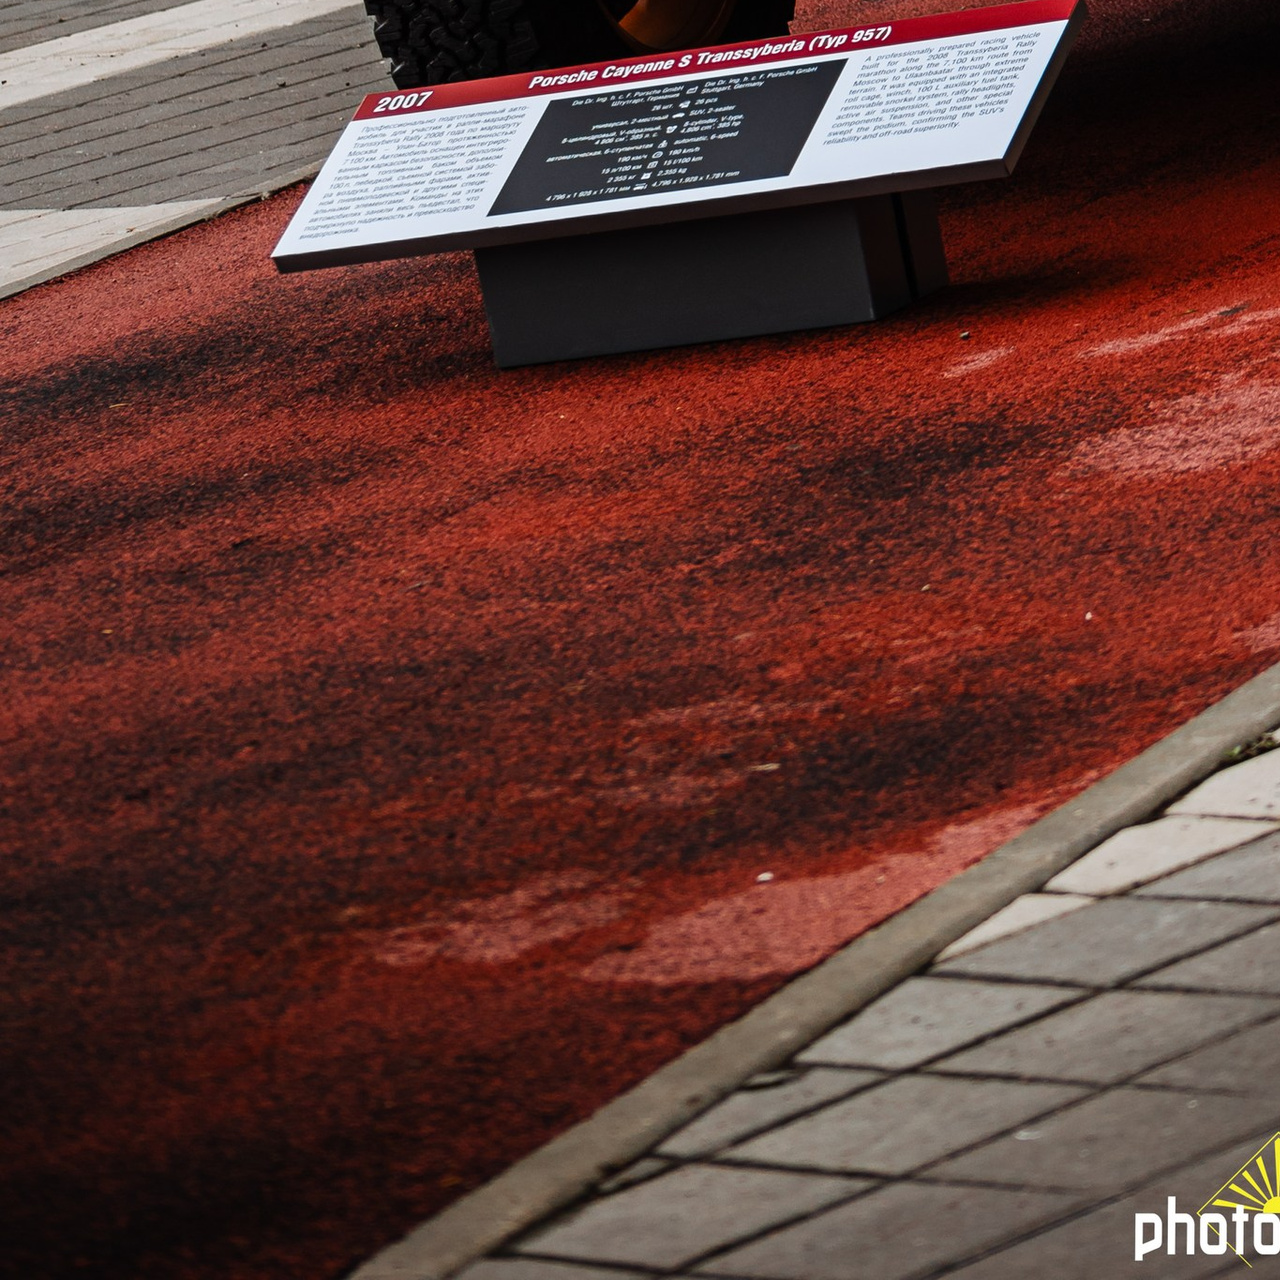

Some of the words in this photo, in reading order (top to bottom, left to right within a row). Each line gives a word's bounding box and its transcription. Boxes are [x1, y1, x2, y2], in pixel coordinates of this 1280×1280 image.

[528, 69, 598, 89] Porsche
[601, 59, 675, 78] Cayenne
[677, 54, 693, 68] S
[696, 41, 807, 67] Transsyberia
[808, 34, 848, 51] (Typ
[851, 25, 892, 43] 957)
[860, 62, 880, 71] built
[926, 51, 949, 61] 2008
[956, 44, 1009, 56] Transsyberia
[1015, 39, 1037, 48] Rally
[864, 55, 872, 63] A
[875, 47, 935, 62] professionally
[937, 40, 977, 53] prepared
[979, 37, 1007, 45] racing
[1011, 31, 1041, 41] vehicle
[852, 77, 888, 87] Moscow
[904, 67, 954, 80] Ulaanbaatar
[957, 61, 991, 72] through
[994, 56, 1029, 67] extreme
[856, 68, 897, 79] marathon
[899, 64, 923, 73] along
[925, 61, 940, 69] the
[943, 56, 968, 66] 7,100
[986, 51, 1009, 60] route
[1012, 48, 1033, 56] from
[843, 95, 860, 104] roll
[860, 93, 882, 101] cage,
[885, 88, 912, 98] winch,
[917, 84, 933, 93] 100
[934, 83, 940, 91] L
[943, 79, 979, 90] auxiliary
[980, 75, 998, 84] fuel
[999, 72, 1019, 82] tank,
[848, 86, 876, 95] terrain.
[907, 75, 948, 87] equipped
[949, 72, 968, 81] with
[982, 64, 1026, 76] integrated
[373, 90, 433, 112] 2007
[835, 111, 861, 120] active
[880, 102, 929, 114] suspension,
[934, 97, 953, 106] and
[955, 95, 979, 103] other
[982, 89, 1014, 100] special
[839, 100, 884, 112] removable
[884, 95, 917, 106] snorkel
[916, 91, 949, 102] system,
[950, 88, 970, 96] rally
[970, 82, 1015, 93] headlights,
[826, 127, 853, 137] swept
[872, 121, 907, 132] podium,
[911, 113, 958, 125] confirming
[978, 106, 1005, 116] SUV's
[831, 116, 884, 129] components.
[888, 111, 916, 120] Teams
[917, 107, 947, 117] driving
[948, 103, 972, 112] these
[974, 98, 1009, 108] vehicles
[822, 135, 862, 145] reliability
[861, 131, 879, 140] and
[878, 126, 914, 138] off-road
[913, 121, 960, 133] superiority.
